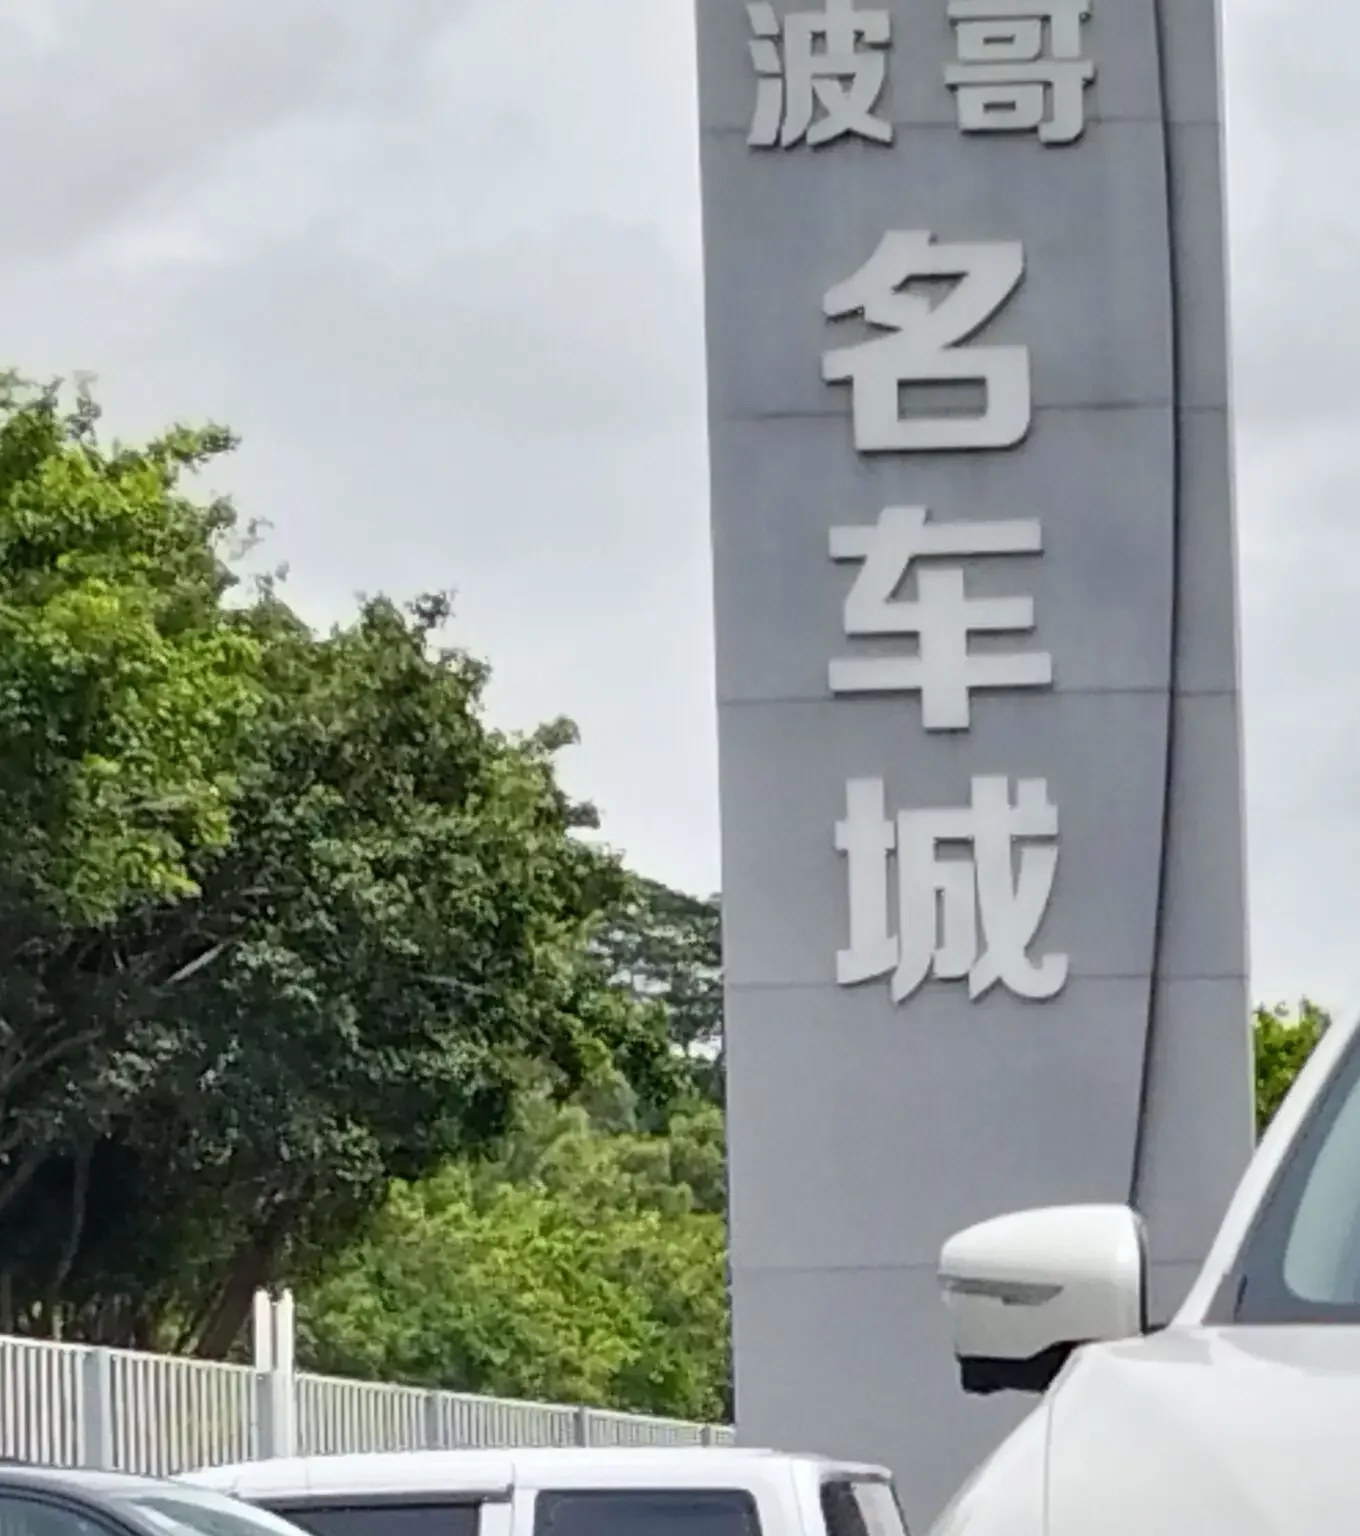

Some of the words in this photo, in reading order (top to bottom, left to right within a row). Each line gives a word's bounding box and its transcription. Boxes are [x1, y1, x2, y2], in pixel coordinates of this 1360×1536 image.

[746, 0, 1098, 149] 波哥
[821, 229, 1069, 1004] 名车城
